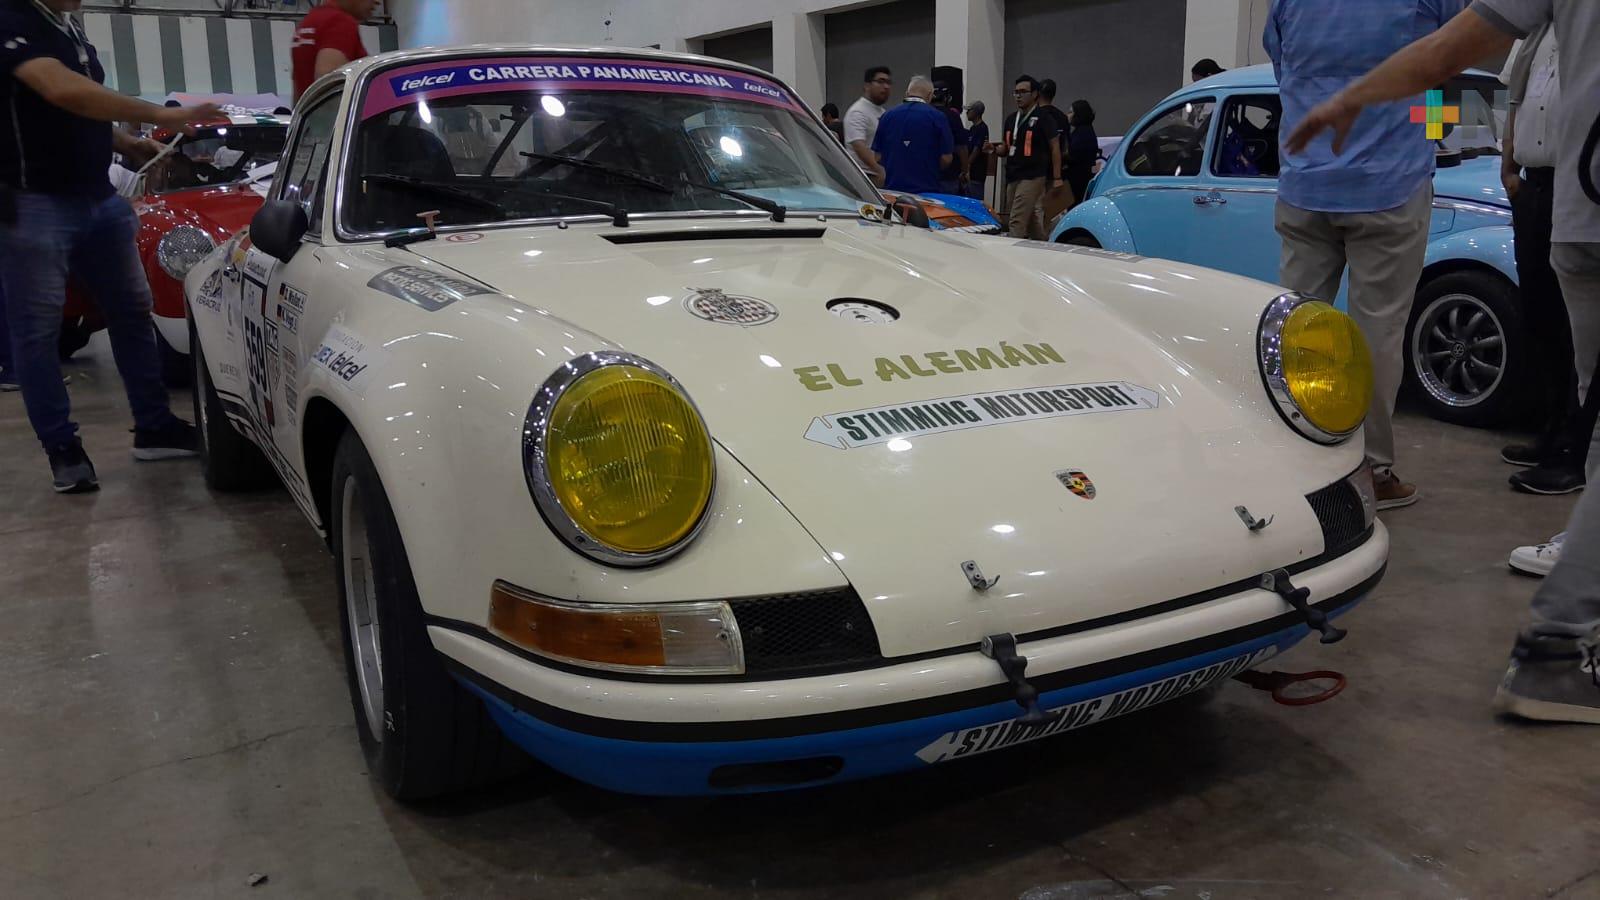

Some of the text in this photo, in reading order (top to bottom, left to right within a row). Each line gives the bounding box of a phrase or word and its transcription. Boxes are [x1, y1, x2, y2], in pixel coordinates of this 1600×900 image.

[401, 65, 782, 98] telcel CARRERA PANAMERICANA telcel
[244, 316, 268, 393] 559
[328, 350, 368, 382] telcel
[793, 341, 1066, 392] EL ALEMÁN
[837, 385, 1139, 442] STIMMING MOTORSPORT
